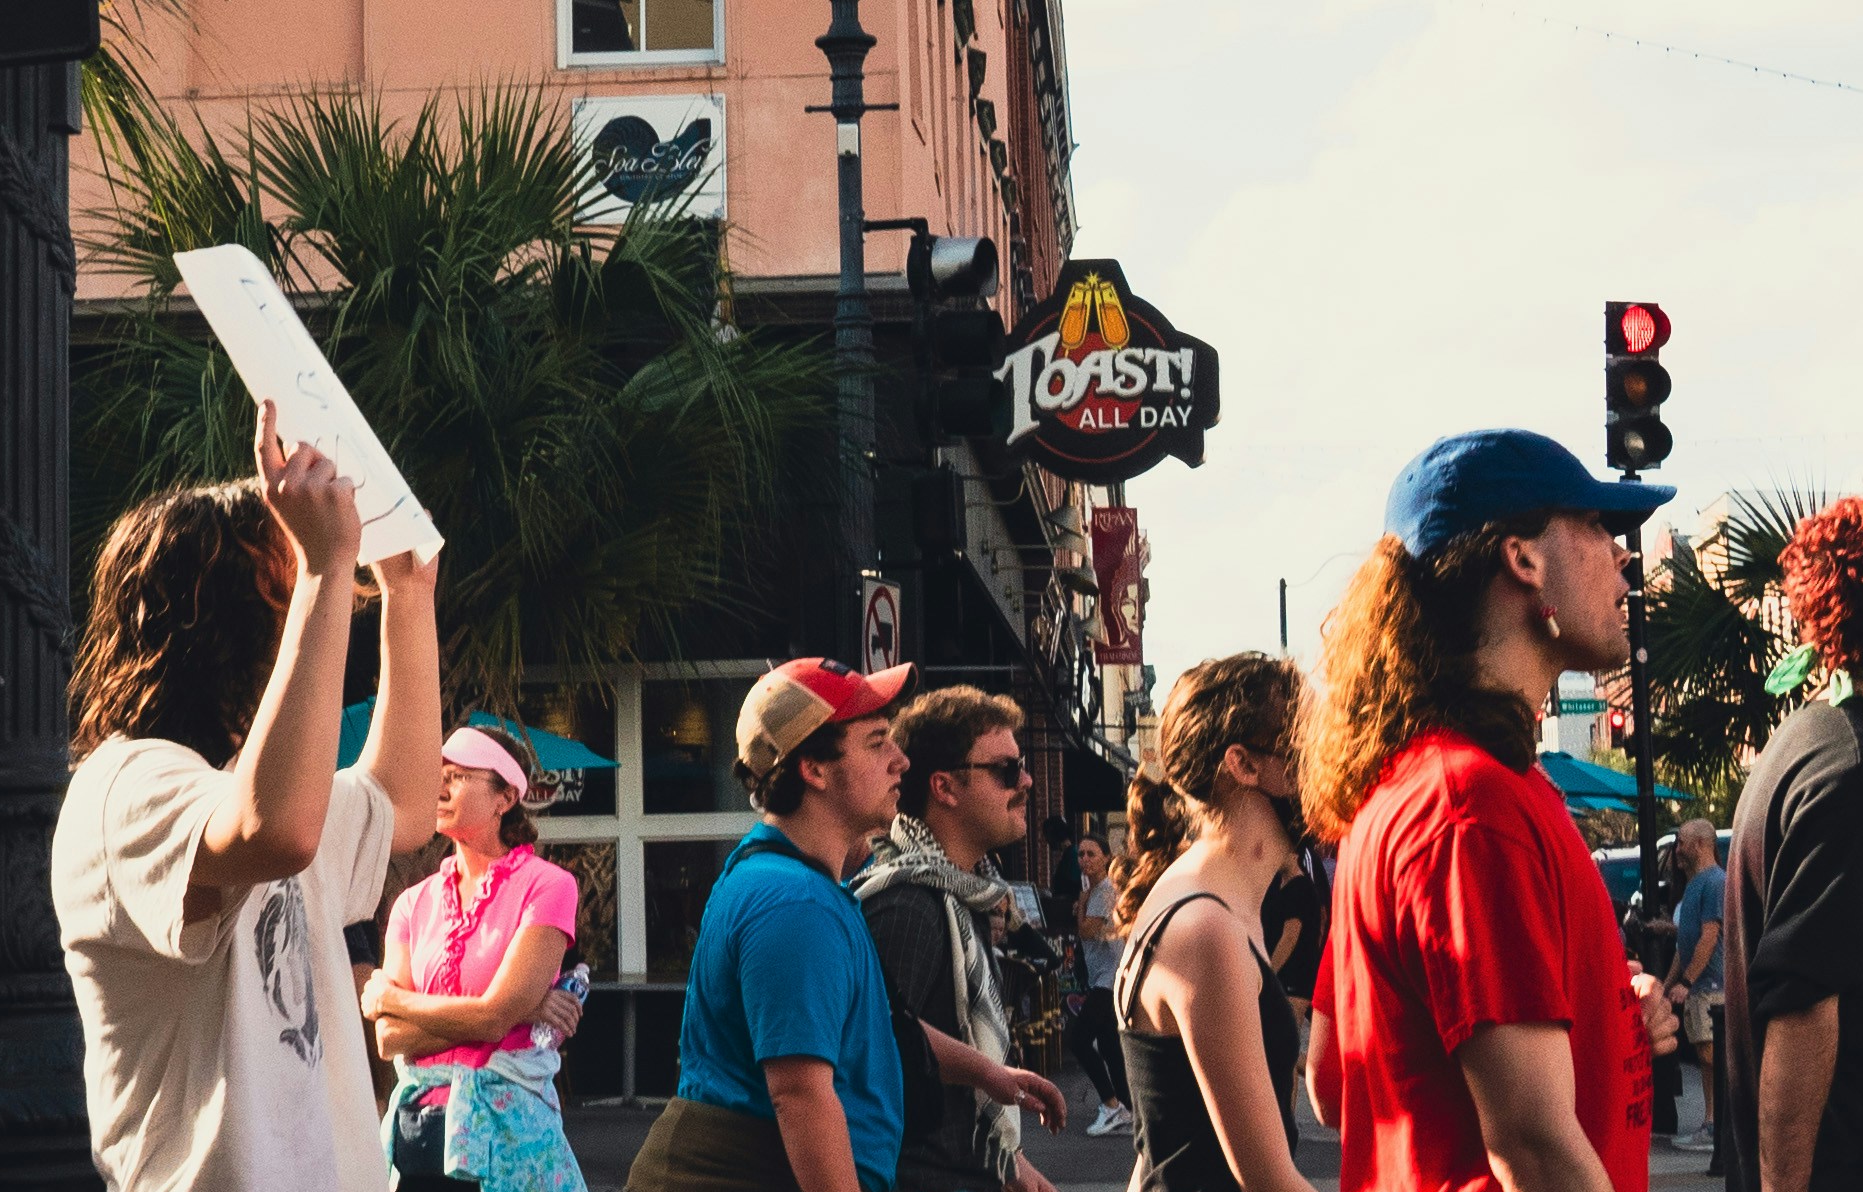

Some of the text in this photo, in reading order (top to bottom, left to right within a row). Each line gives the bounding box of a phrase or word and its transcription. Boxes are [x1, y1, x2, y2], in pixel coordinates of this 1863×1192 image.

[991, 332, 1194, 447] TOAST!
[1078, 405, 1193, 429] ALL DAY
